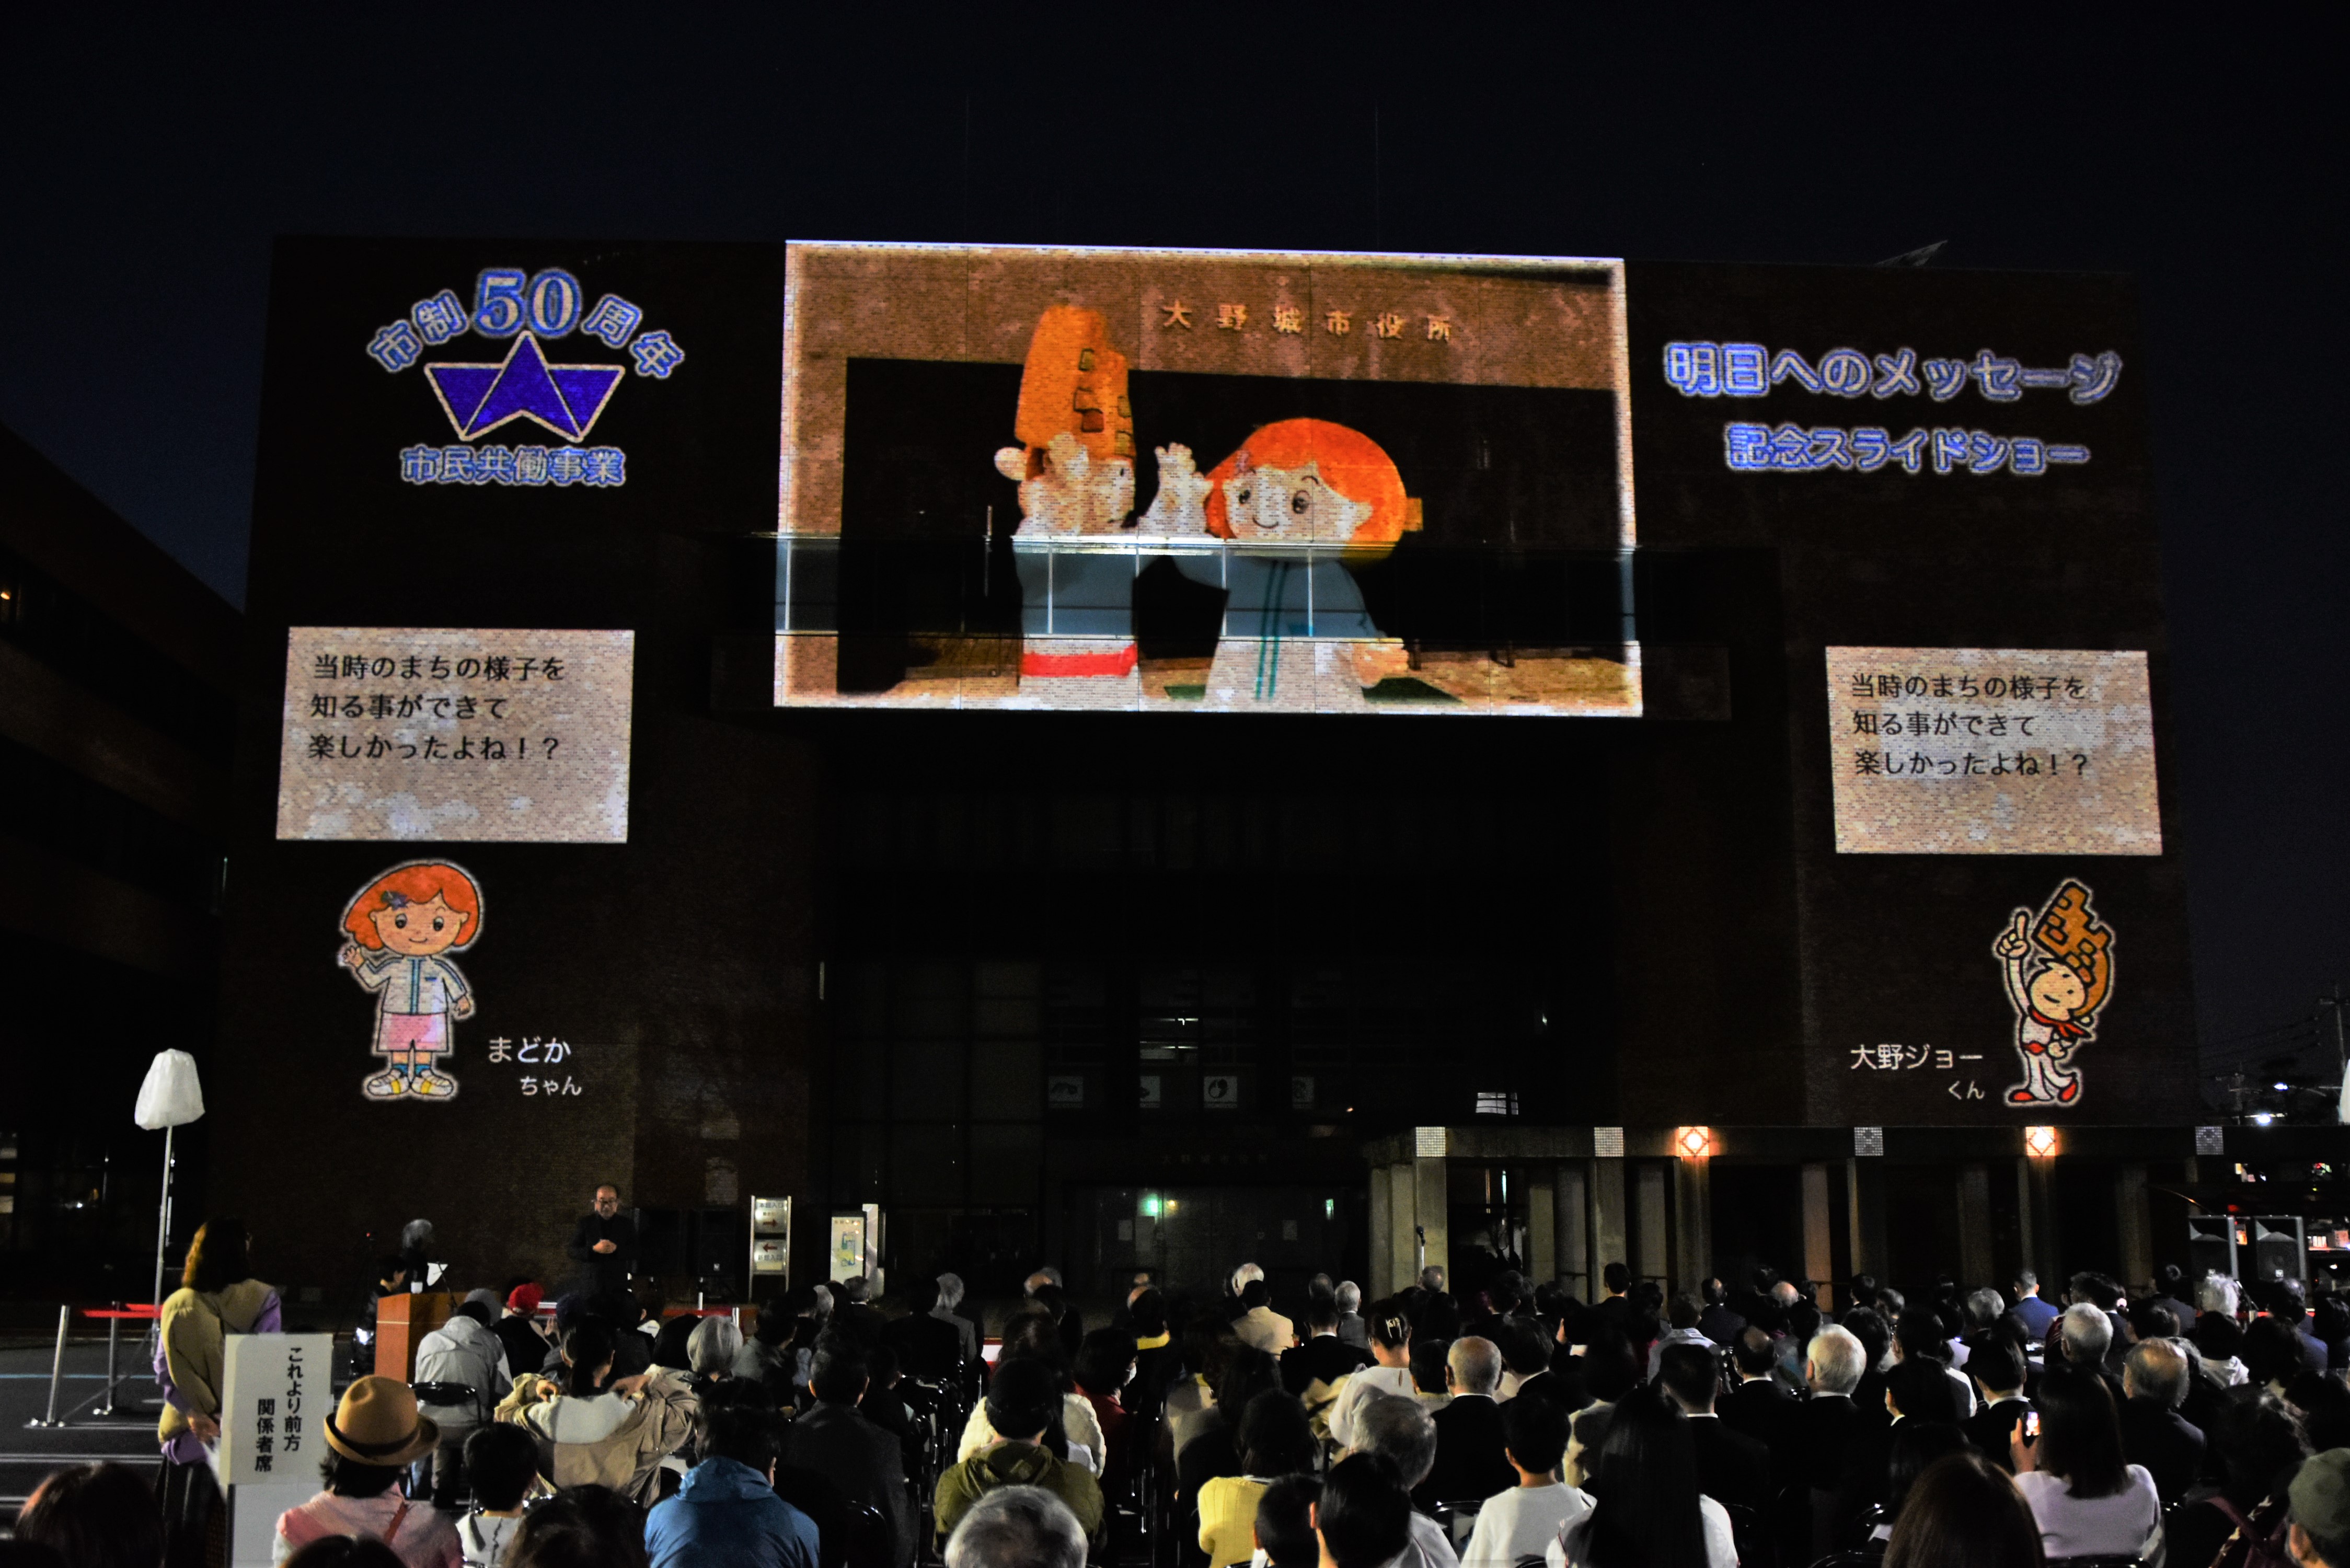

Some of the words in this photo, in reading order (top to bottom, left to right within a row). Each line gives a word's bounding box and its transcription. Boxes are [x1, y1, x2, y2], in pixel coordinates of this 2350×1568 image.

[1162, 299, 1452, 341] 大野城市役所
[1664, 341, 2123, 404] 明日へのメッセージ
[1724, 422, 2090, 474] 記念スライドショー
[400, 444, 626, 487] 市民共働事業
[314, 654, 566, 681] 当時のまちの様子を
[1851, 673, 2087, 699] 当時のまちの様子を
[311, 694, 508, 720] 知る事ができて
[1853, 711, 2035, 736] 知る事ができて
[488, 1035, 572, 1064] まどか
[1850, 1043, 1983, 1070] 大野ジョー
[520, 1075, 582, 1096] ちゃん
[1948, 1080, 1985, 1100] くん
[284, 1346, 303, 1452] これより前方
[255, 1398, 275, 1472] 関係者席
